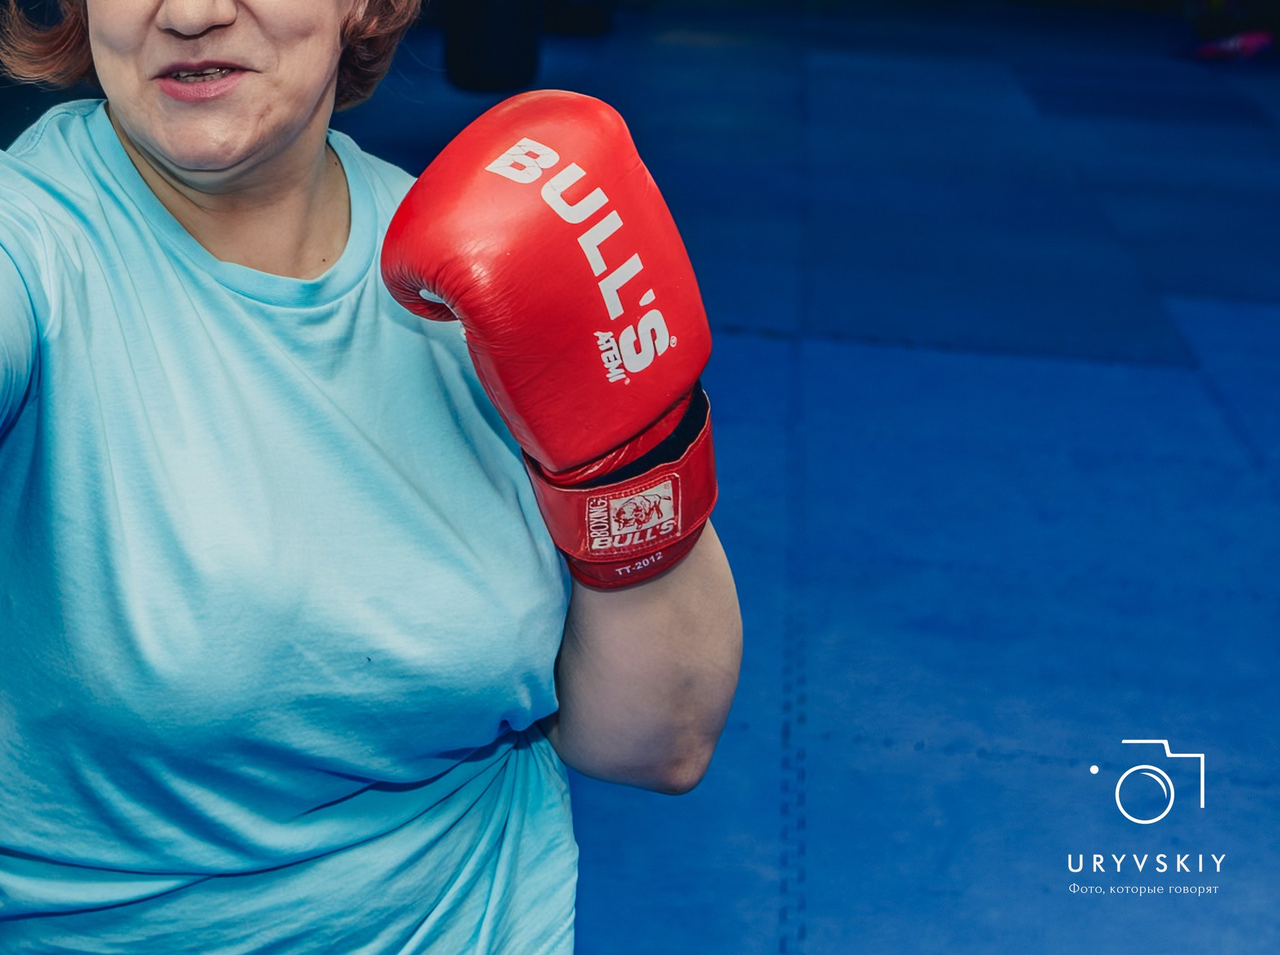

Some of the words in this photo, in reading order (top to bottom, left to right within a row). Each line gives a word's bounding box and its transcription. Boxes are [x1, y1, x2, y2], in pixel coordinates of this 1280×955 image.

[484, 137, 670, 373] BULL'S
[593, 331, 627, 383] ATEMI
[589, 498, 610, 538] BOXING
[591, 519, 674, 550] BULL'S
[615, 551, 663, 575] TT-2012
